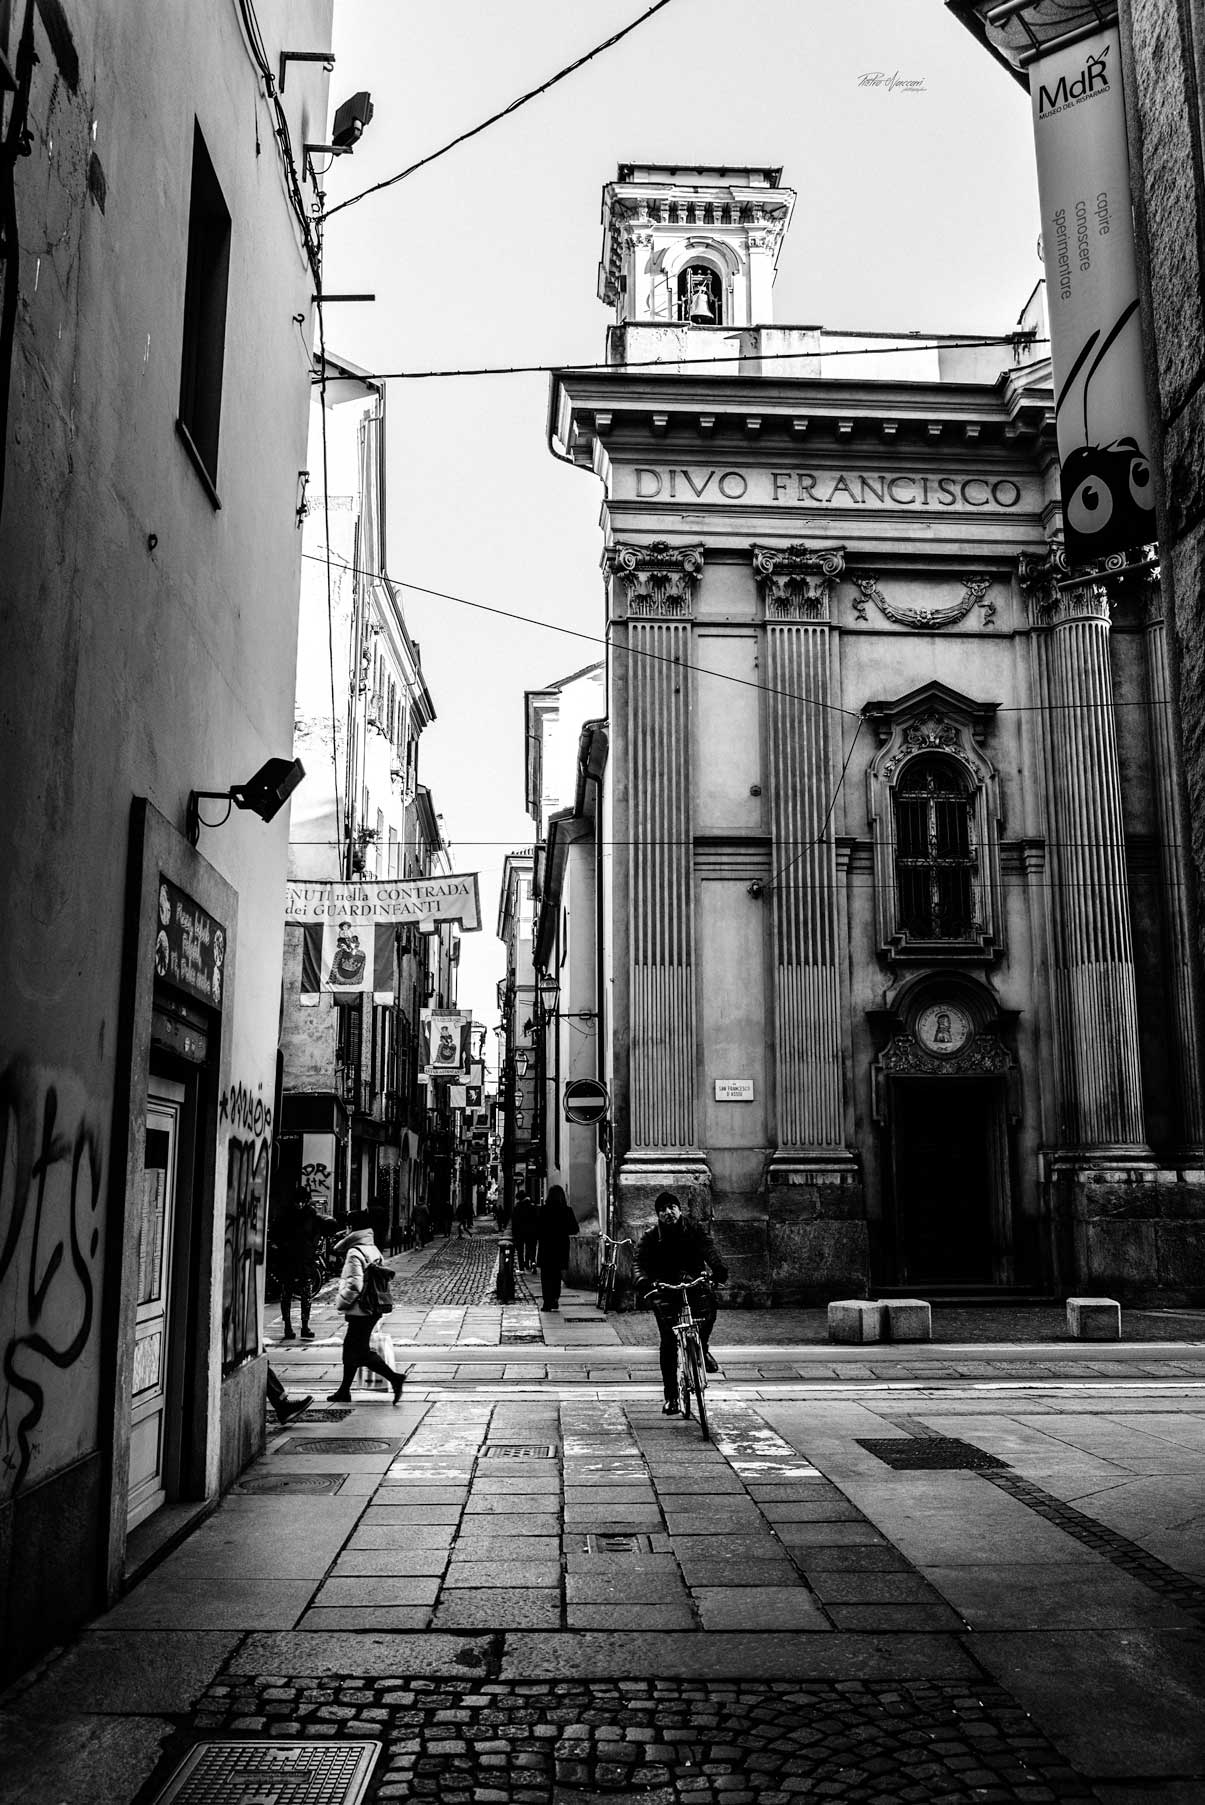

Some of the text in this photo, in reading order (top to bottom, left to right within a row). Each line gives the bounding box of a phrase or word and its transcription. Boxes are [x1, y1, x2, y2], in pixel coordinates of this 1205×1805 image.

[1039, 59, 1109, 114] MdR
[1039, 85, 1111, 121] MUSEO DEL RISPARMIO
[1094, 192, 1112, 236] capire
[1052, 208, 1073, 300] sperimentare
[1075, 201, 1091, 272] conoscere
[634, 468, 1021, 508] DIVO FRANCISCO
[285, 900, 441, 917] dei GUARDINFANTI
[336, 887, 370, 902] nella
[376, 883, 470, 902] CONTRADA
